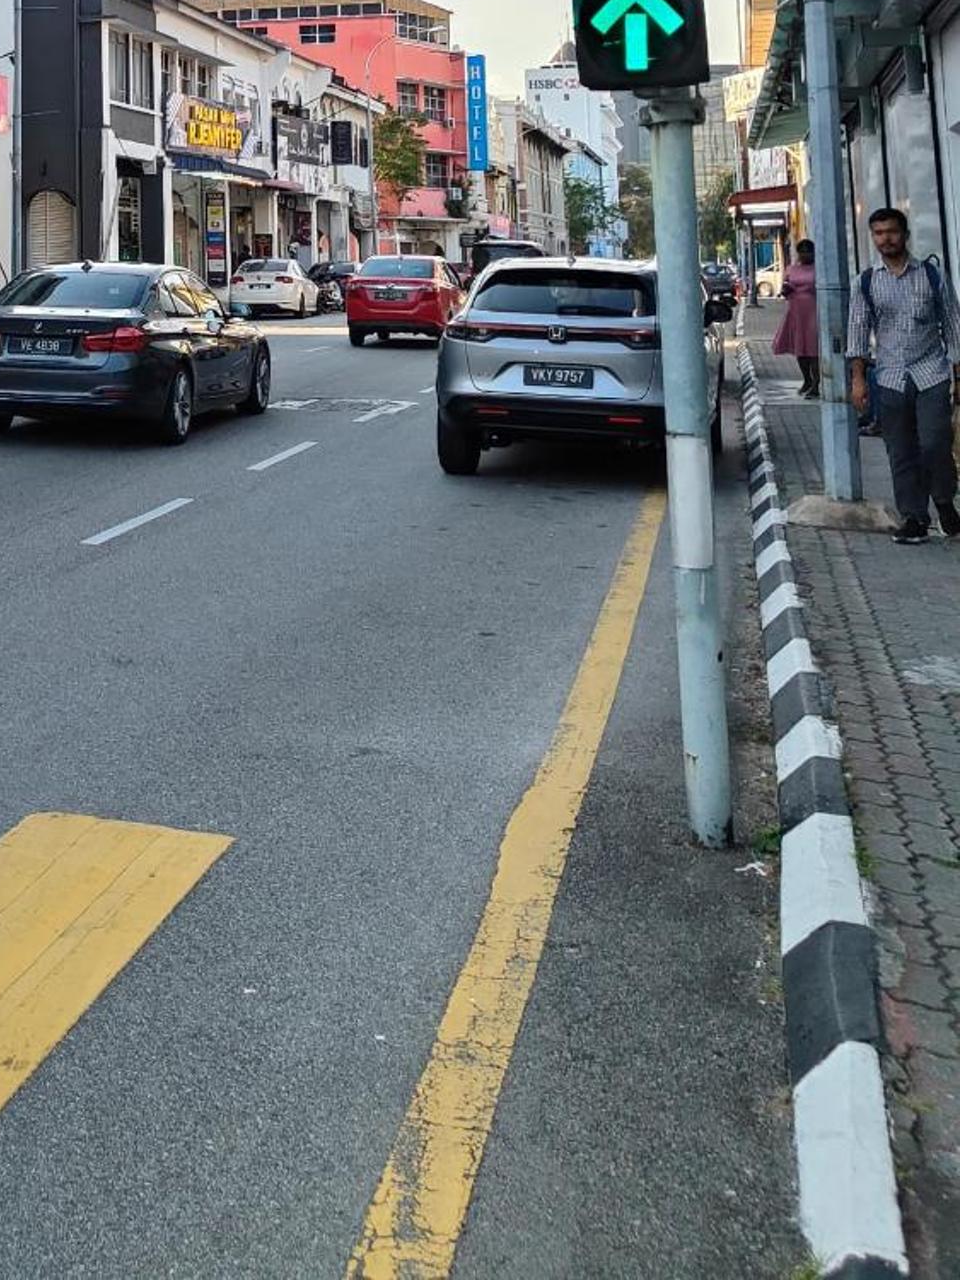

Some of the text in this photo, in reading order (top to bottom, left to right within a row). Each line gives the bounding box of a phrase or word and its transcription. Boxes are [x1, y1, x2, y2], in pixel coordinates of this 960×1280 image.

[529, 78, 563, 90] HSBC
[471, 66, 482, 161] HOTEL
[531, 368, 584, 383] VKY 9757
